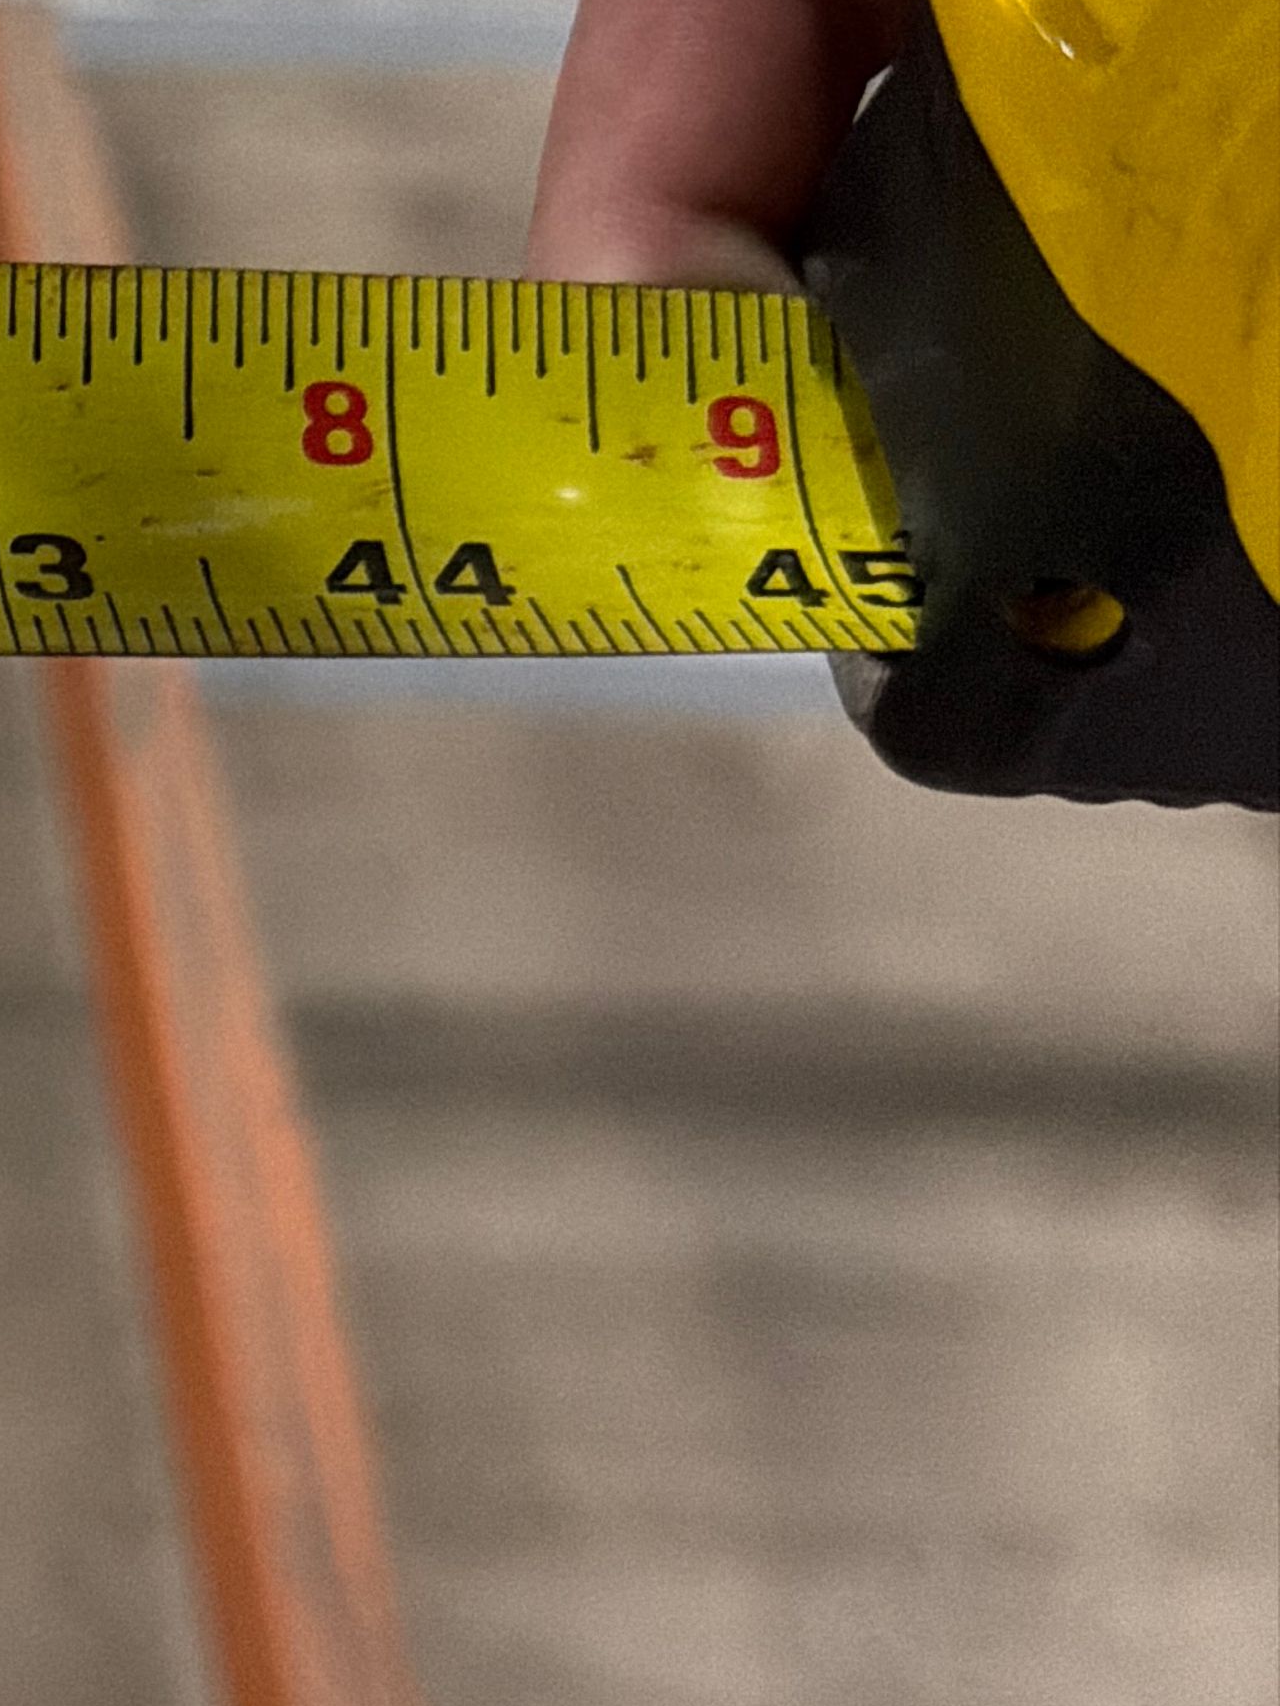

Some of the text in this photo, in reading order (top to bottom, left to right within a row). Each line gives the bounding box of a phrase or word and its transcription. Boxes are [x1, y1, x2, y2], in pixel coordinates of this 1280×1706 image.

[301, 380, 374, 467] 8
[707, 395, 782, 479] 9
[323, 539, 517, 606] 44
[744, 548, 926, 608] 45
